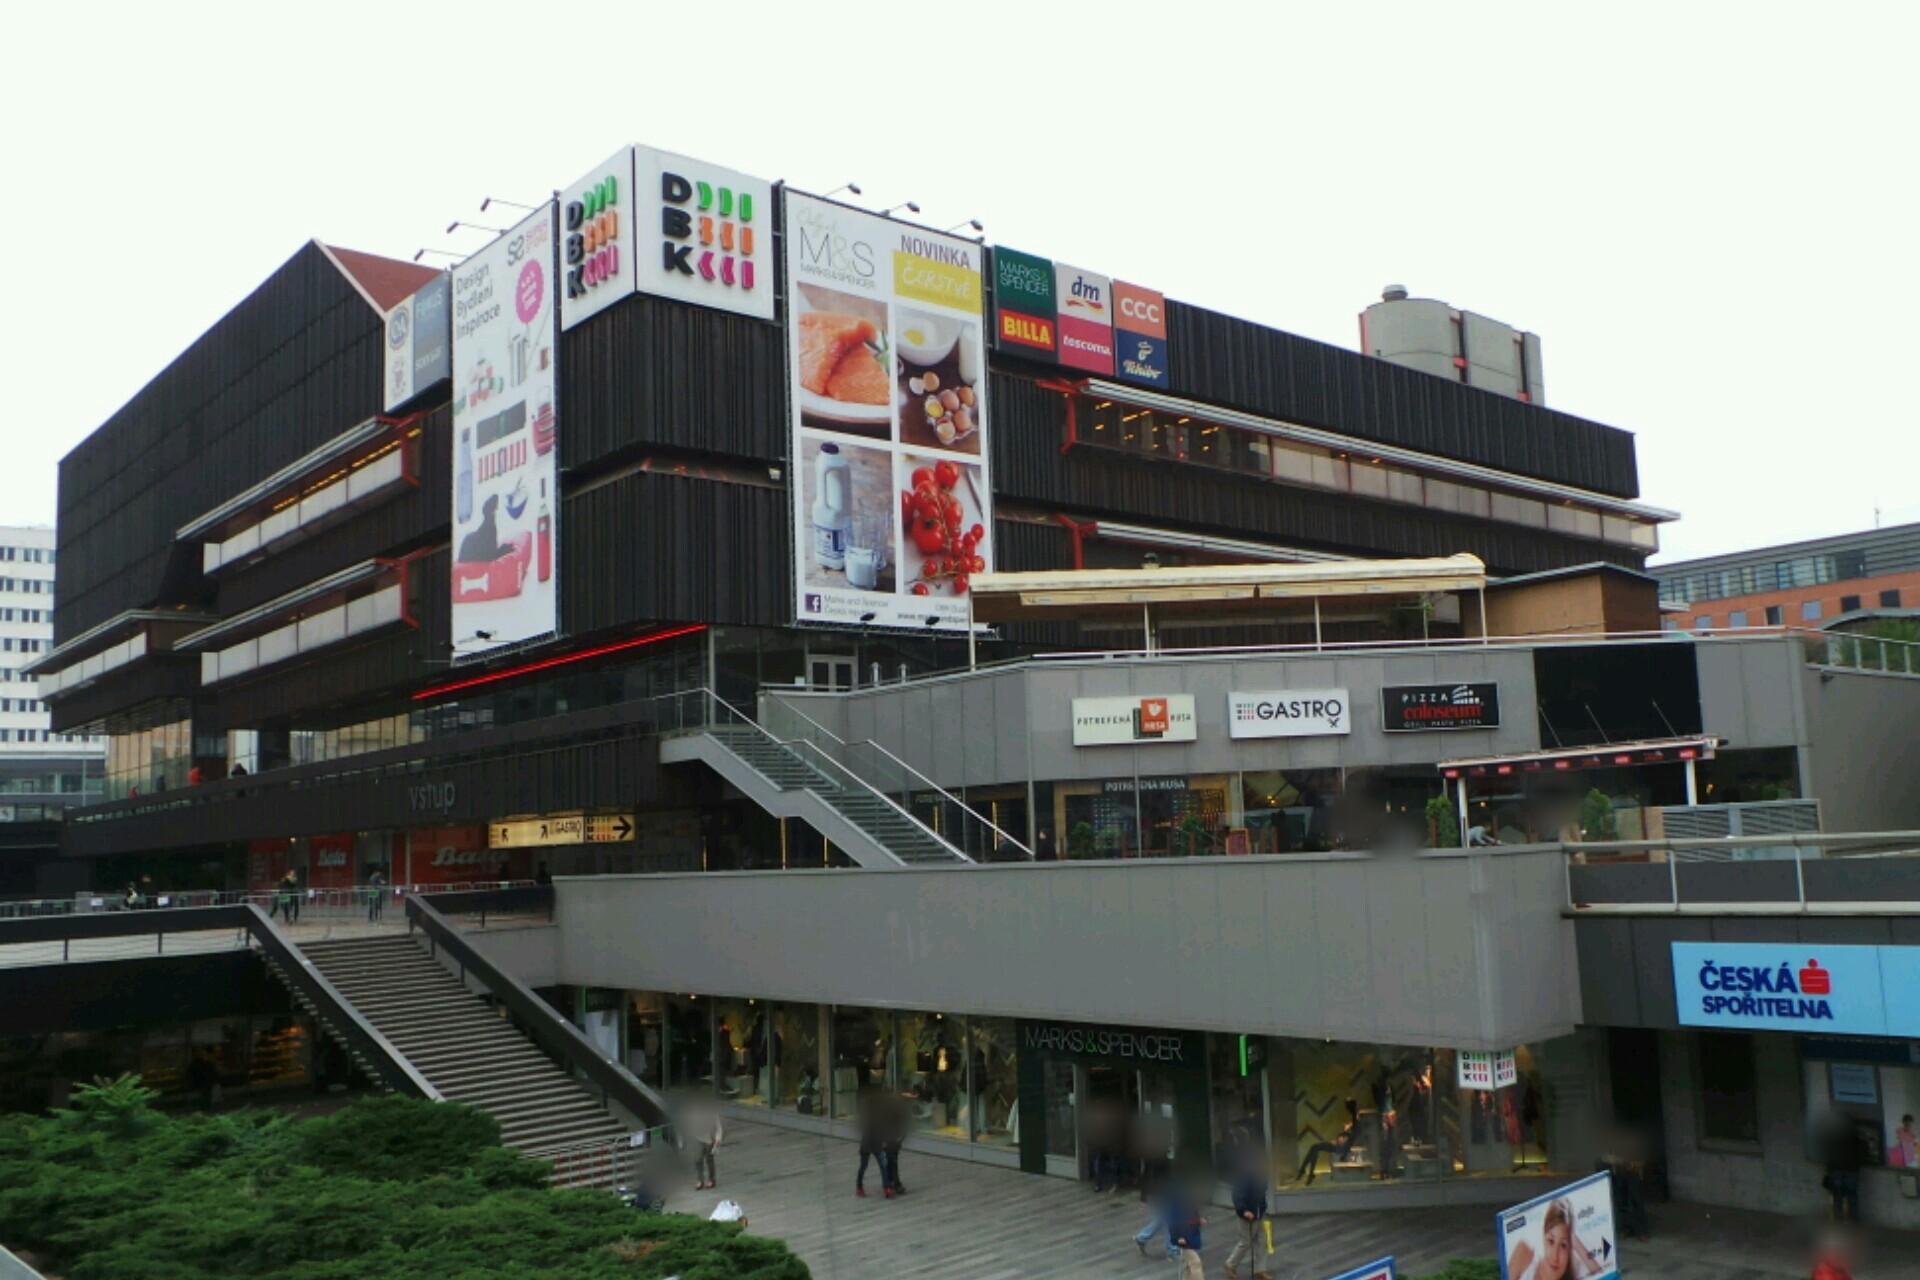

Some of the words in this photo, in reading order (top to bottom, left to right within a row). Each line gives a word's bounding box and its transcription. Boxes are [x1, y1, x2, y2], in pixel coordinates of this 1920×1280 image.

[800, 226, 875, 278] M&S
[900, 234, 971, 270] NOVINKA
[456, 263, 489, 295] Design
[1000, 273, 1050, 297] SPENCER
[1071, 276, 1100, 301] dm
[1120, 297, 1160, 324] CCC
[1003, 315, 1051, 345] BILLA
[1122, 359, 1163, 381] Tchibo
[1257, 699, 1342, 720] GASTRO
[1401, 692, 1449, 704] PIZZA
[409, 781, 456, 814] vstup
[1699, 960, 1798, 994] ČESKÁ
[1702, 992, 1834, 1020] SPOŘITELNA
